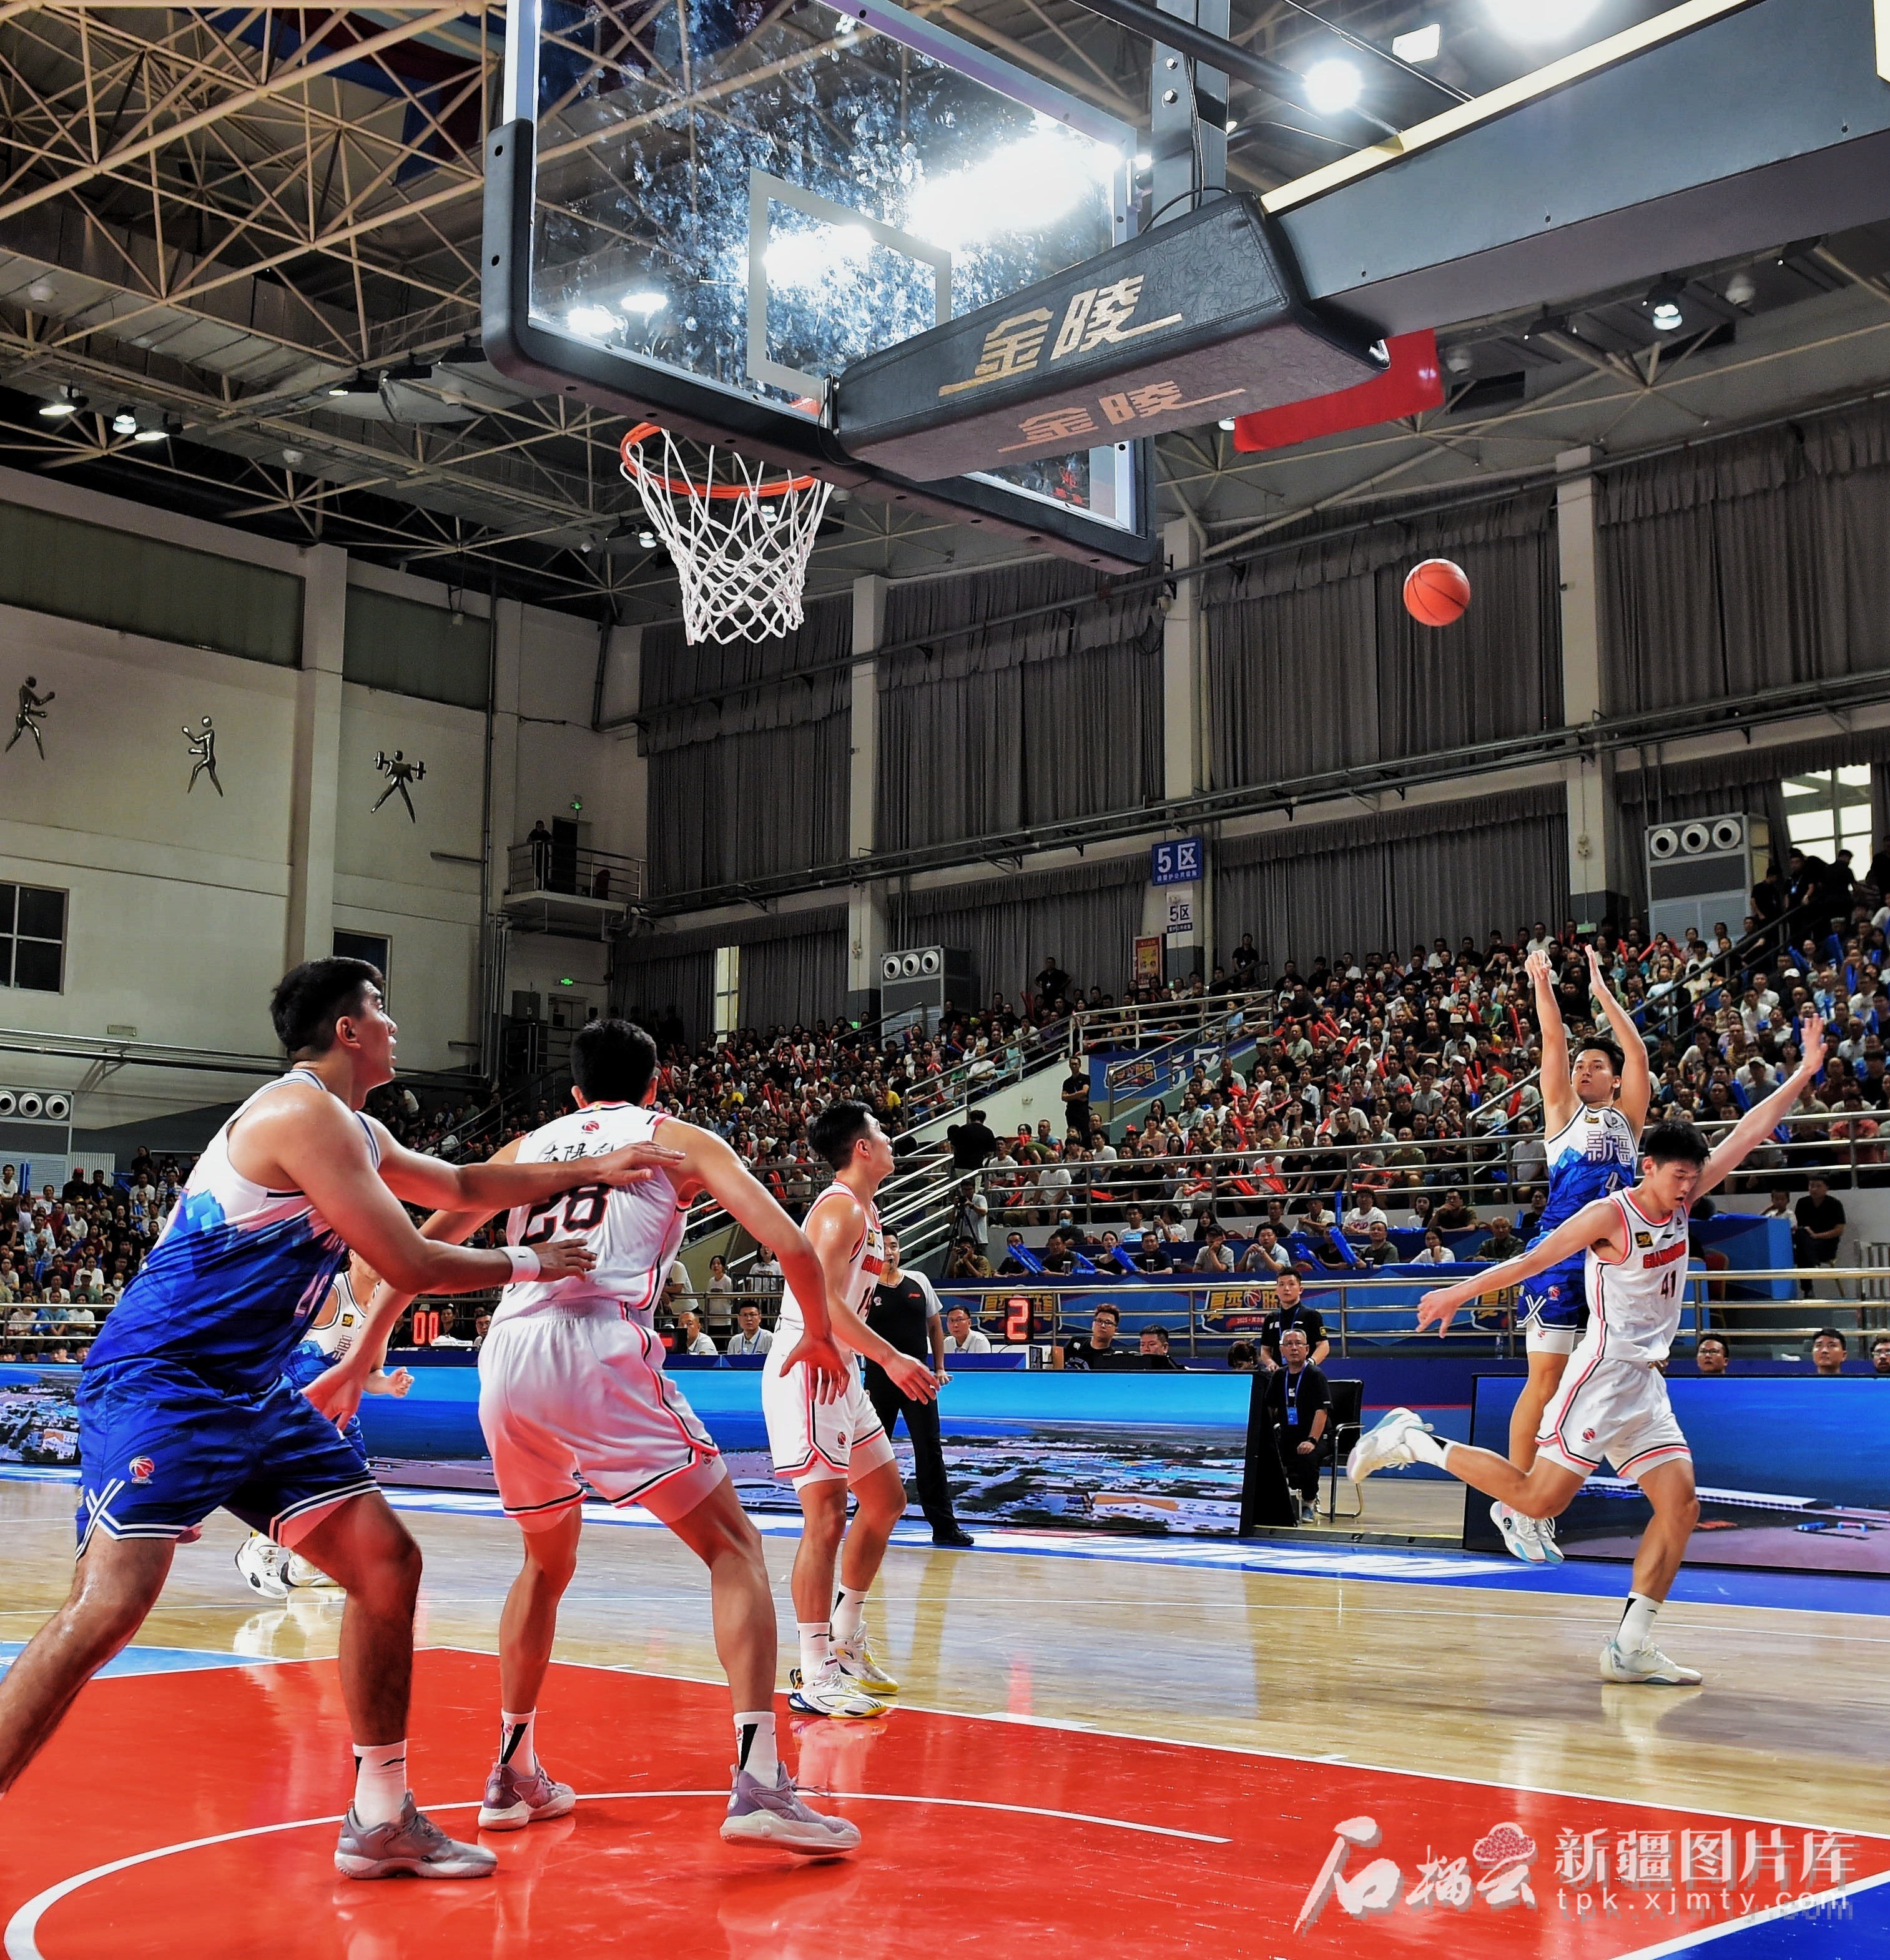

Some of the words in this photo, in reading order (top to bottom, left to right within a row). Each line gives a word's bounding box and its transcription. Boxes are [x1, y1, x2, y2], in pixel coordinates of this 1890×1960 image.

[938, 274, 1183, 397] 金陵
[997, 380, 1246, 453] 金陵
[1158, 842, 1197, 873] 5区
[1169, 904, 1190, 922] 5区
[1586, 1131, 1631, 1166] 新疆
[1660, 1271, 1677, 1299] 41
[1007, 1299, 1028, 1341] 2
